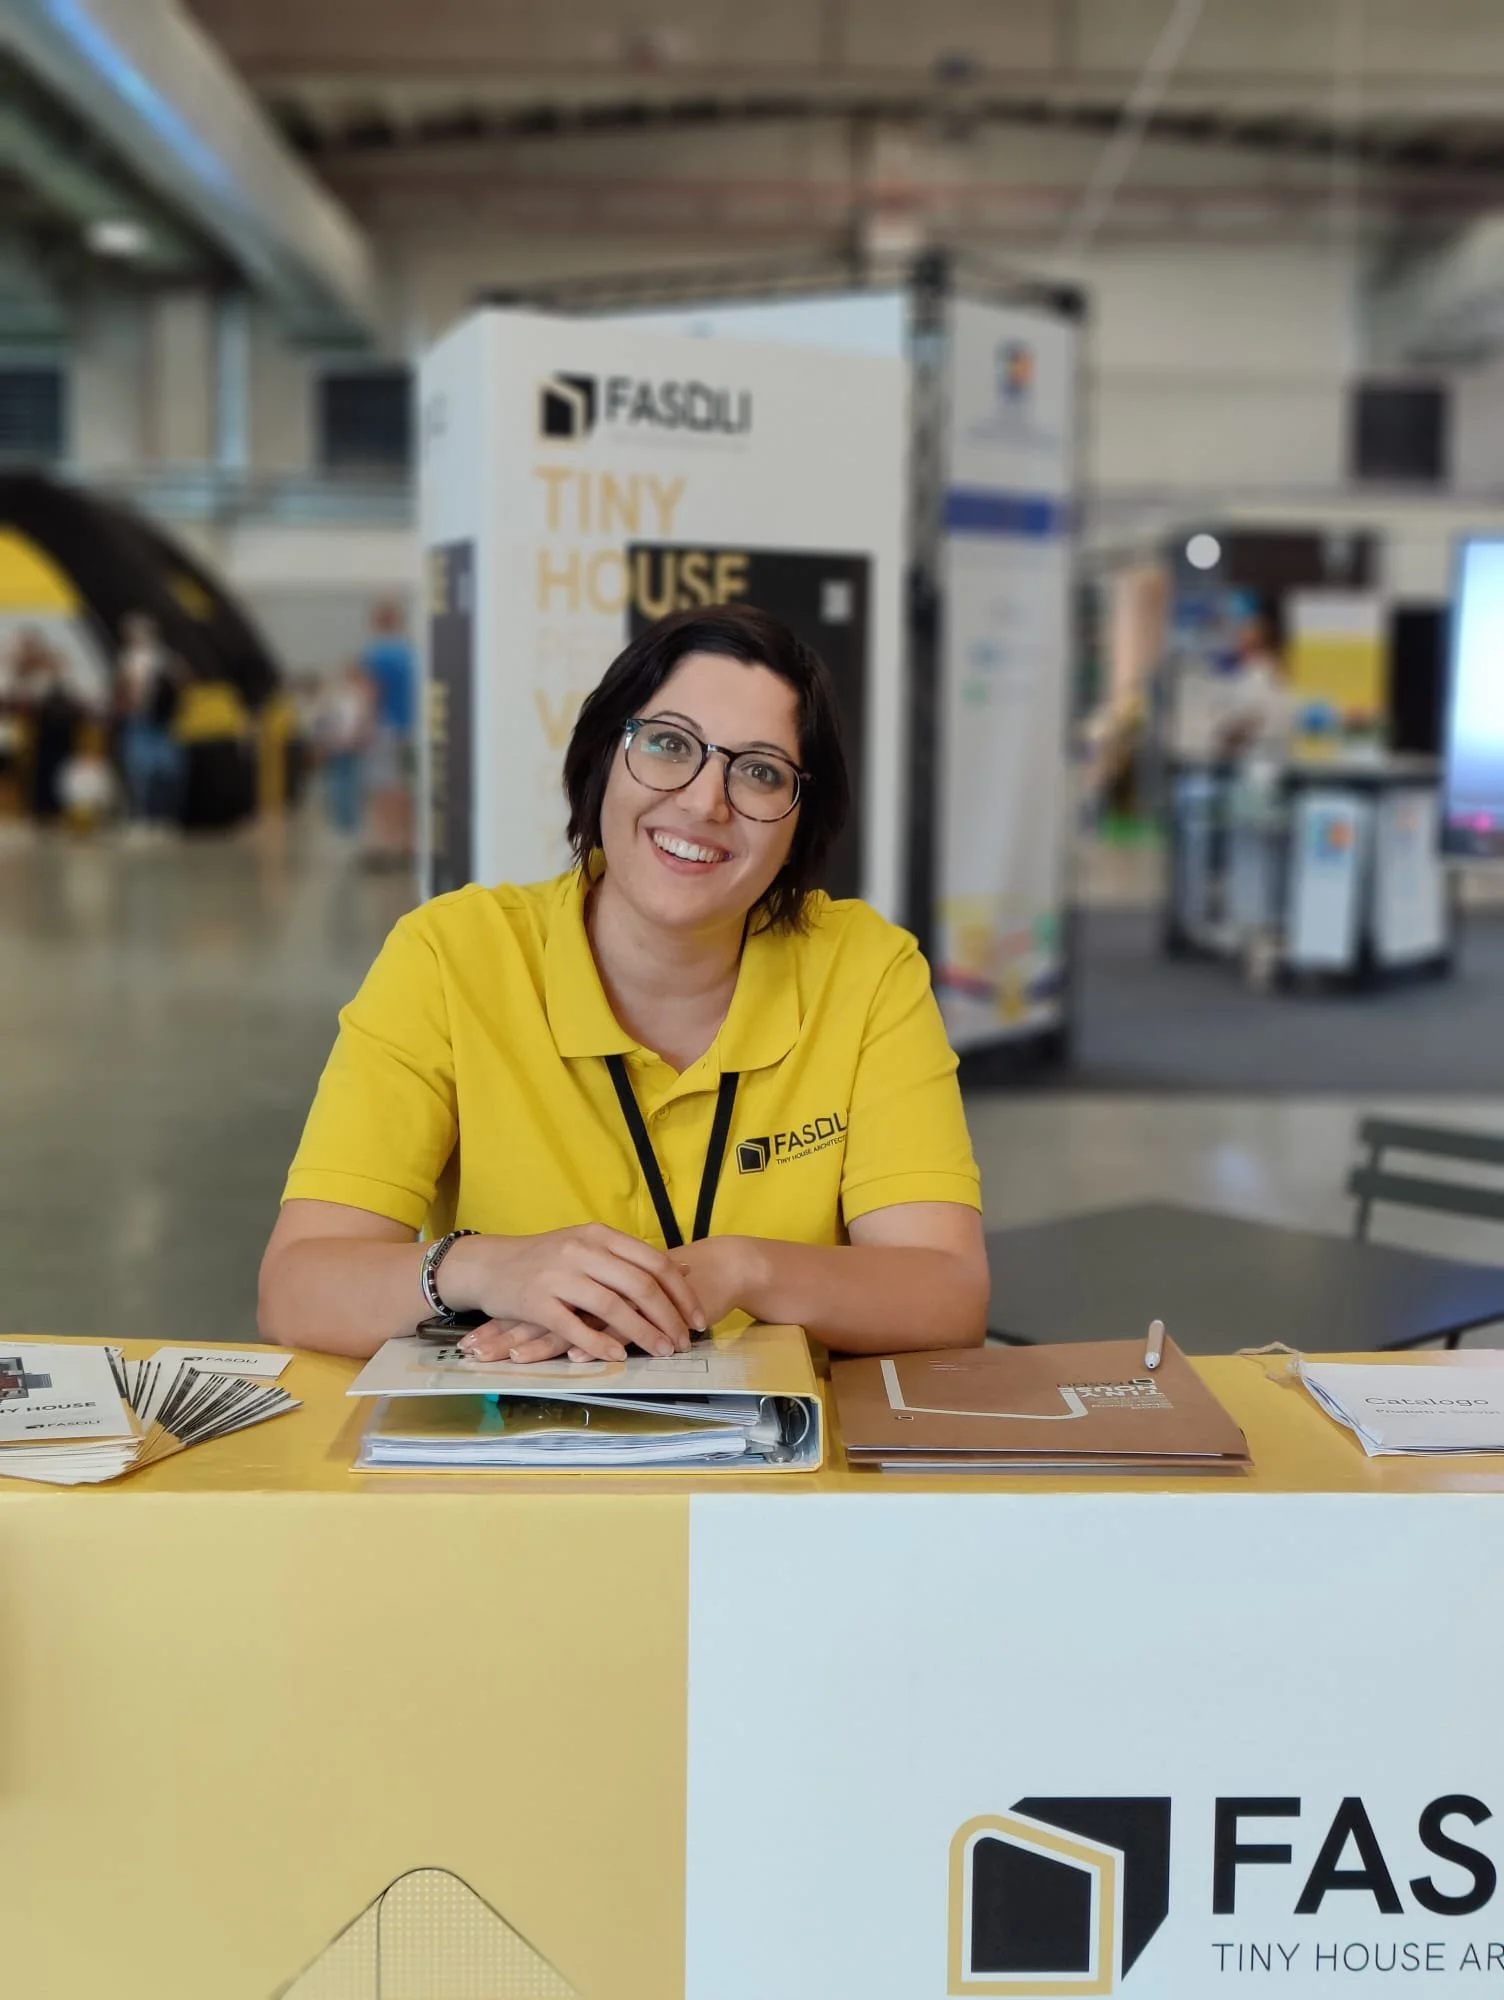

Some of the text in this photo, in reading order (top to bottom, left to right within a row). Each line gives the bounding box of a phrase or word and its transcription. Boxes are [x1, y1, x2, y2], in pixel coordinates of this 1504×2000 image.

[603, 374, 753, 435] FASOLI
[531, 464, 688, 535] TINY
[535, 548, 750, 619] HOUSE
[774, 1112, 848, 1155] FASOL
[776, 1156, 791, 1166] TINY
[792, 1148, 812, 1161] HOUSE
[26, 1402, 97, 1412] HOUSE
[1365, 1398, 1488, 1407] Catalogo
[1211, 1793, 1498, 1917] FAS
[1211, 1942, 1301, 1972] TINY
[1315, 1942, 1446, 1972] HOUSE
